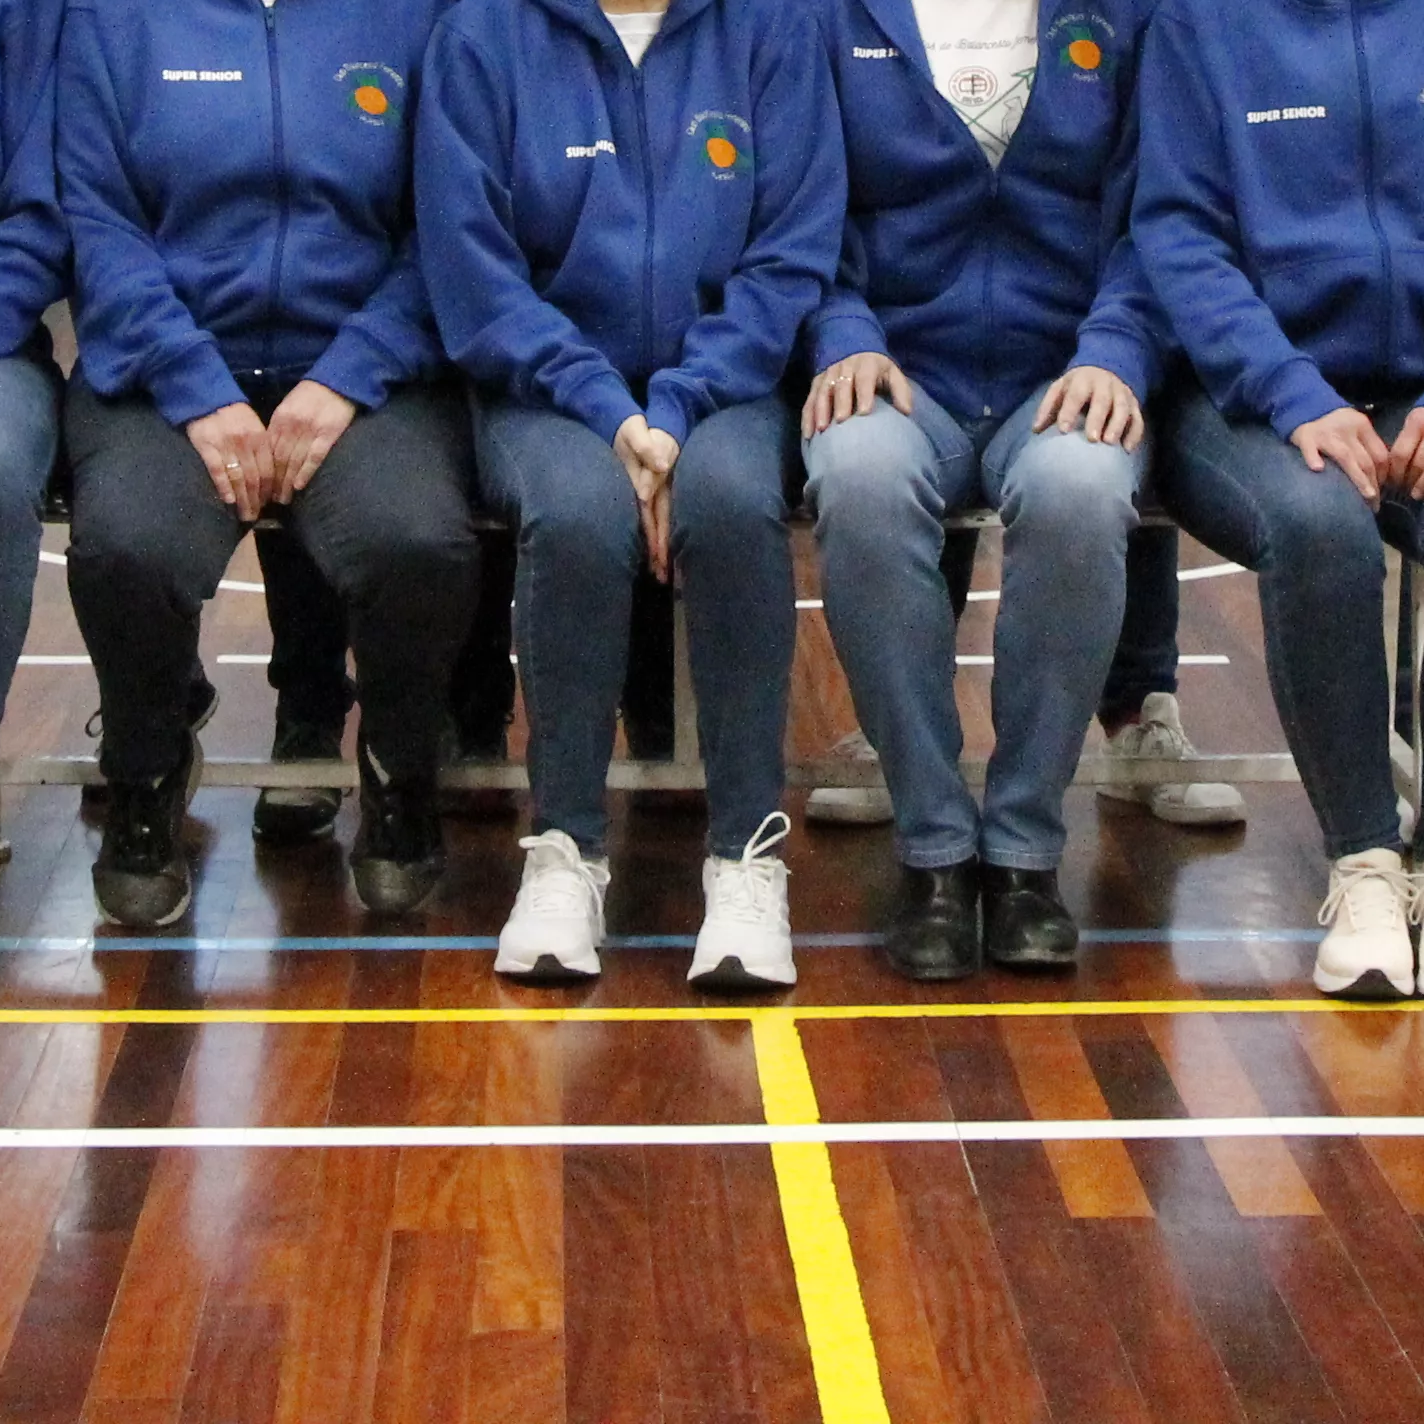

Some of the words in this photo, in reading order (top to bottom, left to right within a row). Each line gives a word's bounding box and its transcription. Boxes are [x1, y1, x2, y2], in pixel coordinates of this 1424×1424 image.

[853, 46, 886, 59] SUPER
[162, 69, 198, 81] SUPER
[199, 70, 243, 81] SENIOR
[1246, 109, 1281, 124] SUPER
[1282, 105, 1327, 120] SENIOR
